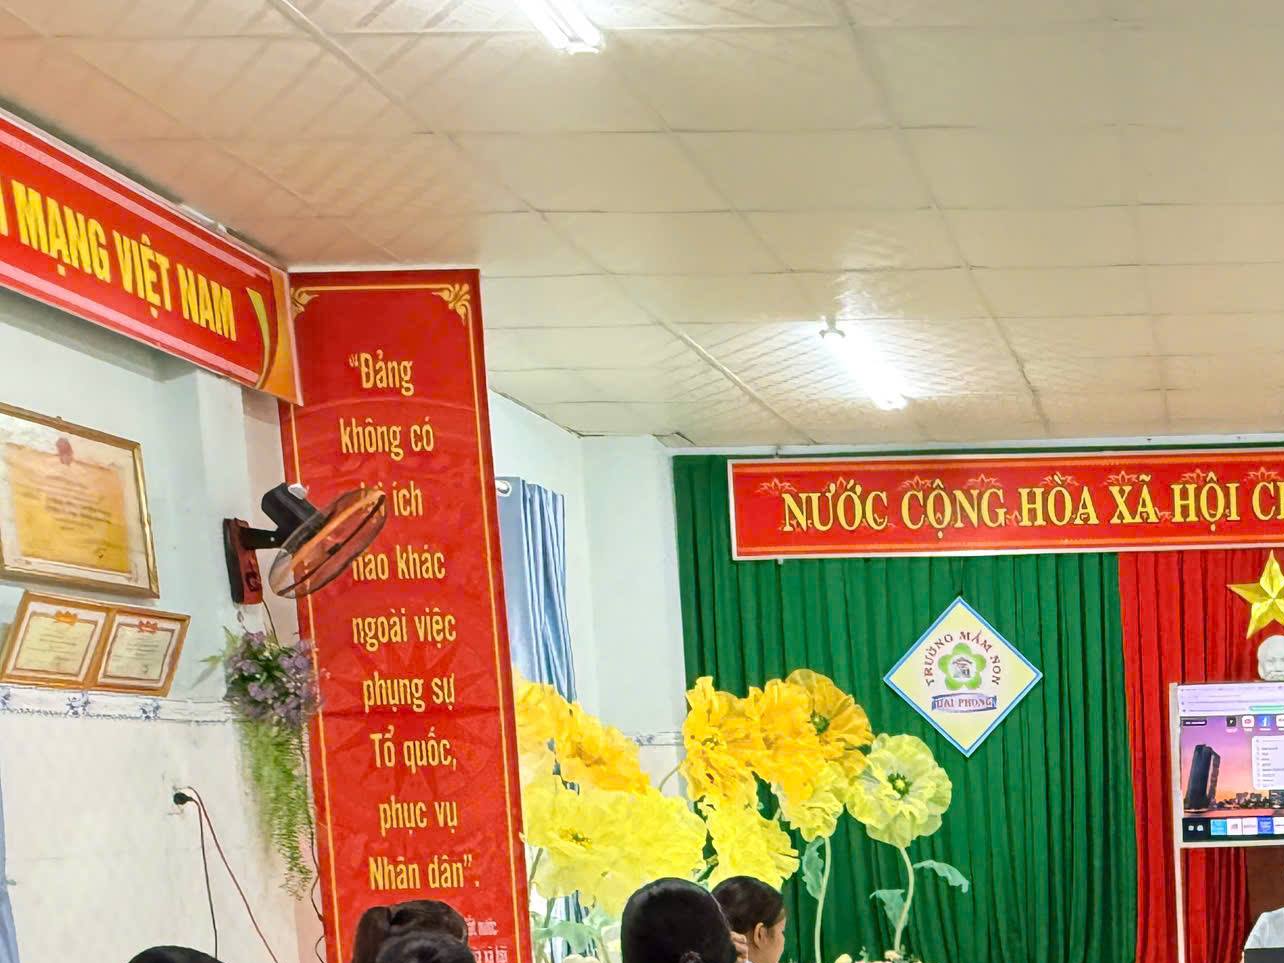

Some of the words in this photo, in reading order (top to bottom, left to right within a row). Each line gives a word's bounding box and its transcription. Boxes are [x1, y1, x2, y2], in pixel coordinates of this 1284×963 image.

[12, 178, 112, 283] MẠNG
[113, 233, 173, 319] VIỆT
[177, 263, 237, 342] NAM
[340, 416, 404, 462] không
[410, 416, 434, 452] có
[392, 480, 424, 517] ích
[780, 478, 888, 532] NƯỚC
[901, 478, 1007, 539] CỘNG
[1016, 472, 1100, 527] HÒA
[1110, 475, 1163, 525] XÃ
[1170, 470, 1241, 532] HỘI
[395, 544, 446, 580] khác
[352, 607, 408, 652] ngoài
[414, 607, 457, 649] việc
[362, 671, 426, 713] phụng
[432, 672, 455, 711] sự
[369, 724, 396, 768] Tổ
[403, 726, 457, 774] quốc,
[378, 794, 428, 837] phục
[434, 801, 458, 834] vụ
[368, 854, 421, 891] Nhân
